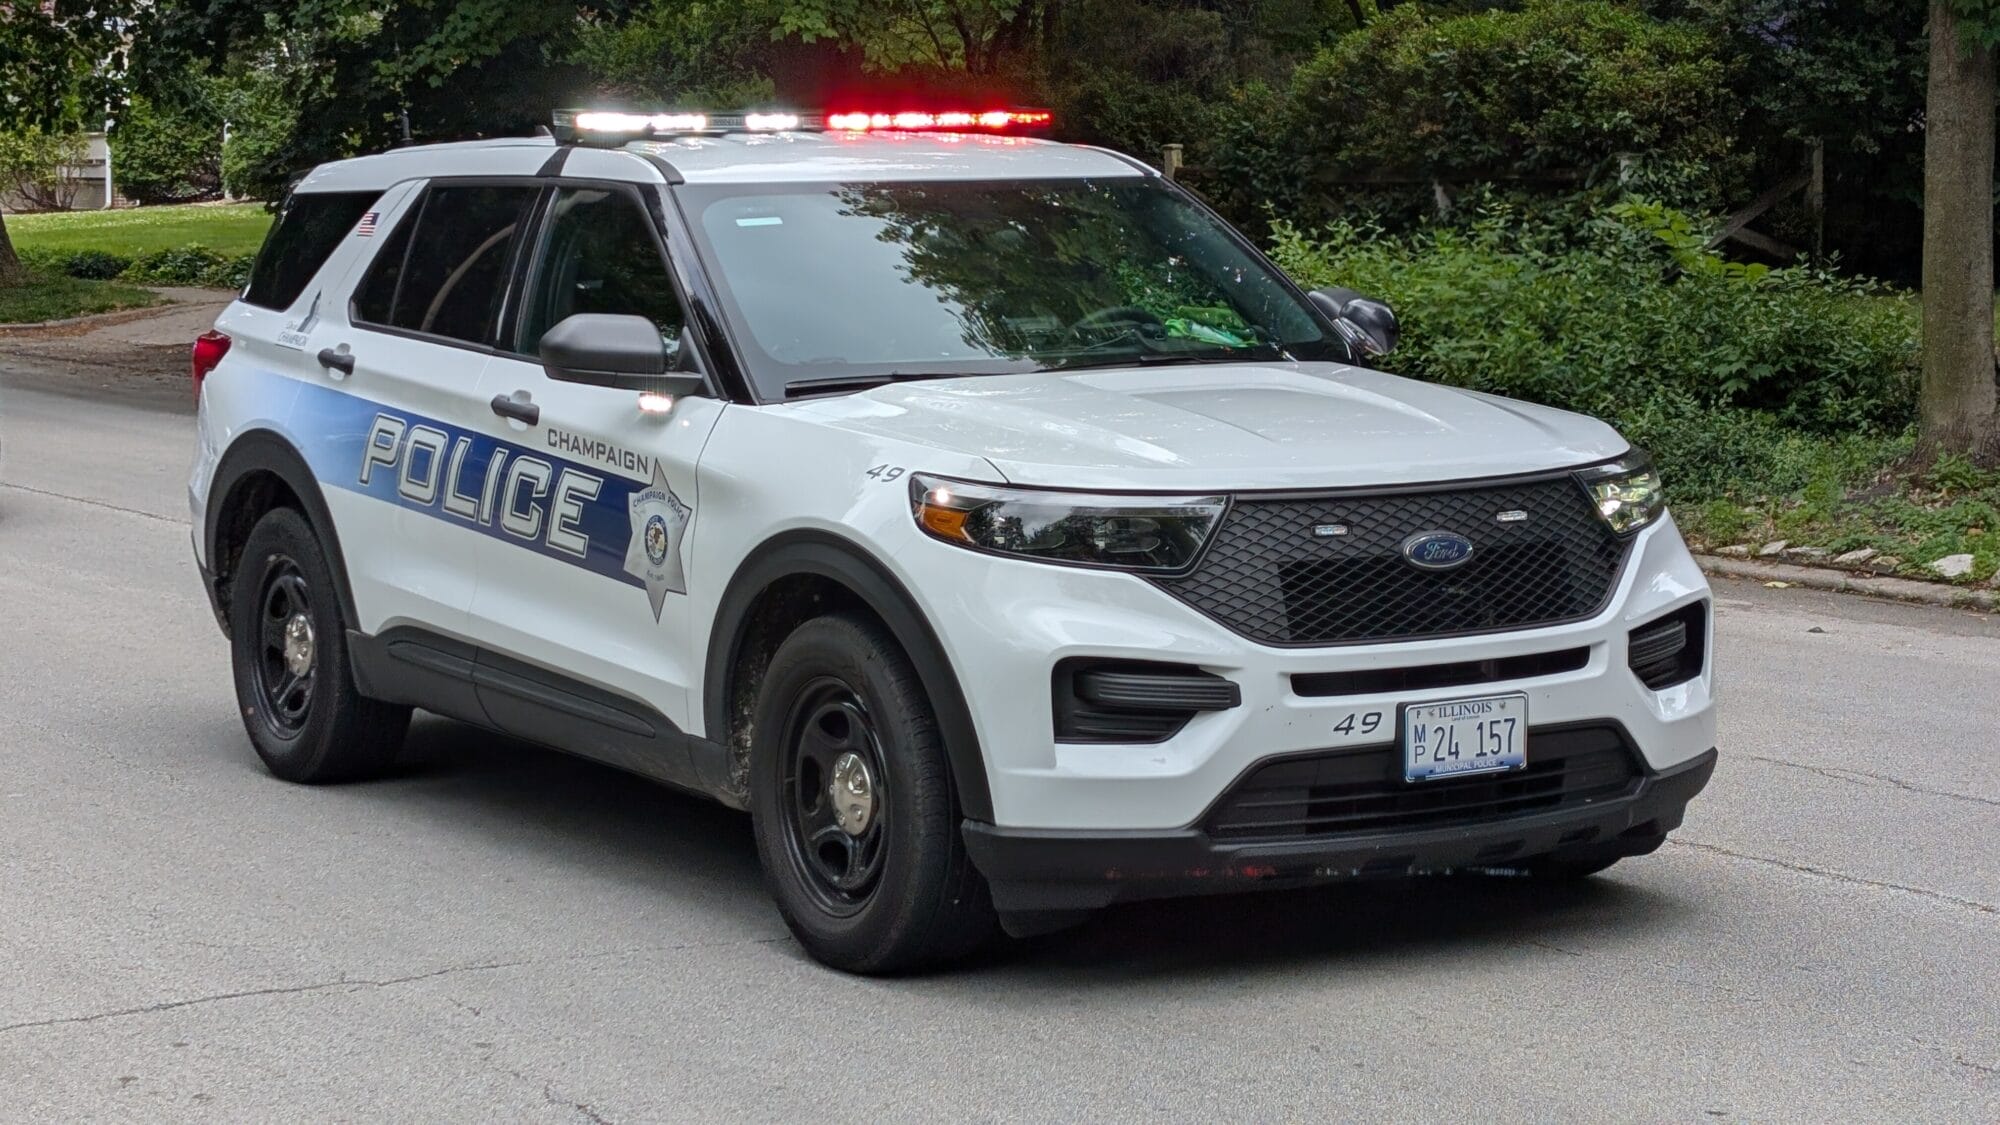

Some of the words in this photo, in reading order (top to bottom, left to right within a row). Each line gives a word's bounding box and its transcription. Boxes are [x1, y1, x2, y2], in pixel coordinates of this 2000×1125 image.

[547, 428, 648, 475] CHAMPAIGN
[866, 464, 906, 482] 49
[358, 412, 604, 559] POLICE
[1424, 541, 1459, 560] Ford
[1439, 702, 1492, 718] ILLINOIS
[1333, 712, 1382, 736] 49
[1433, 725, 1460, 762] 24
[1476, 718, 1516, 758] 157
[1435, 762, 1472, 774] MUNICIPAL
[1474, 758, 1498, 769] POLICE
